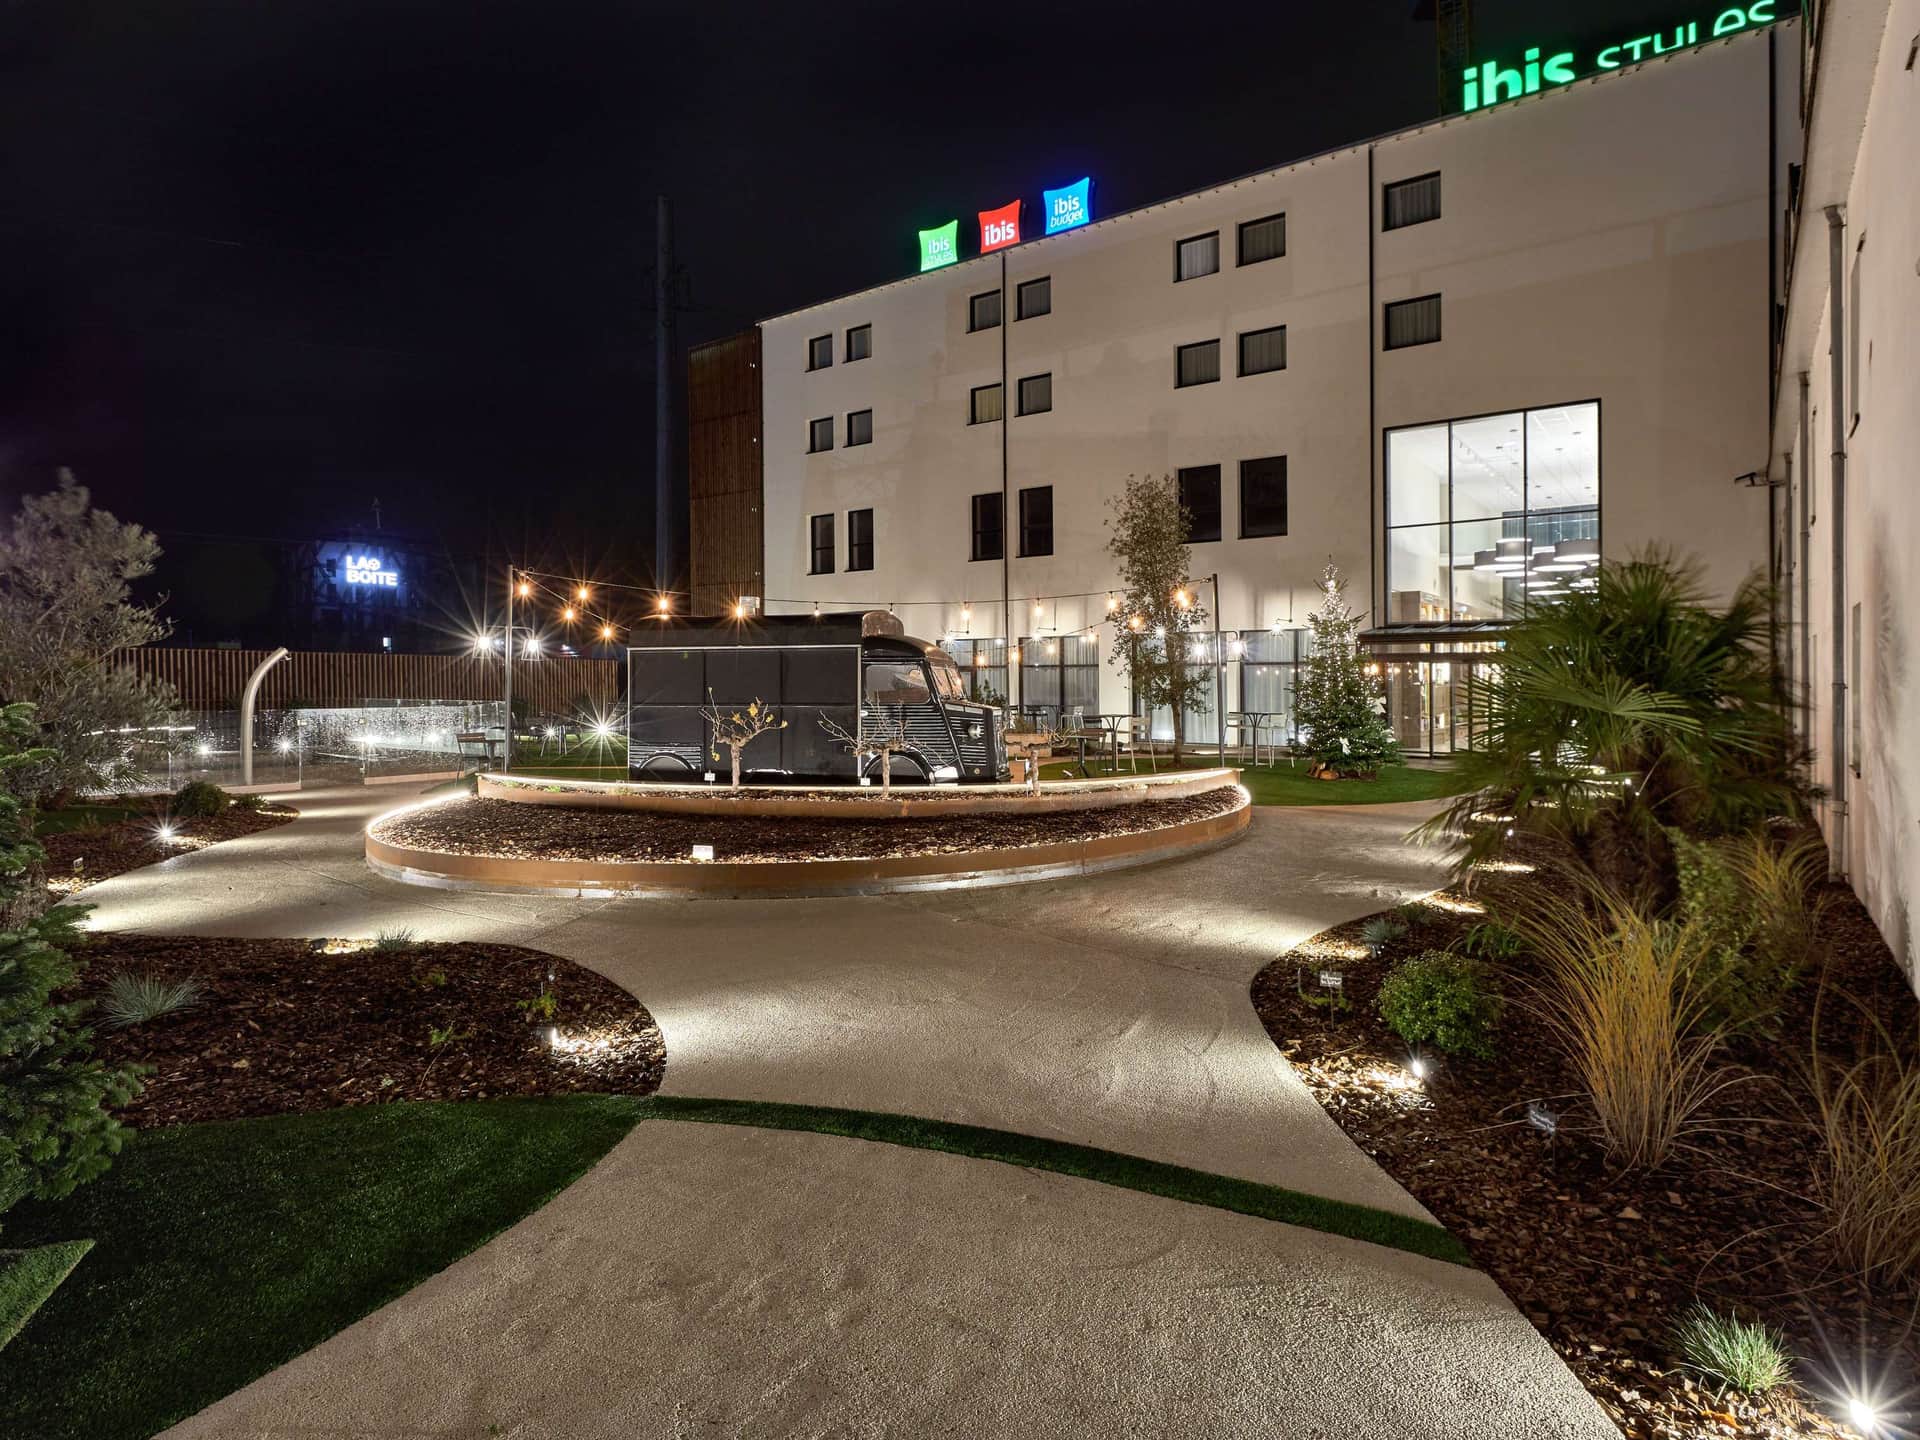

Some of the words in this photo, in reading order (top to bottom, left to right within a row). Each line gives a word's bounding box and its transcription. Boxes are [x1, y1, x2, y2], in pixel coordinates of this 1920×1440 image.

[1054, 194, 1080, 217] ibis
[1050, 208, 1084, 228] budget
[984, 220, 1016, 247] ibis
[928, 236, 950, 255] ibis
